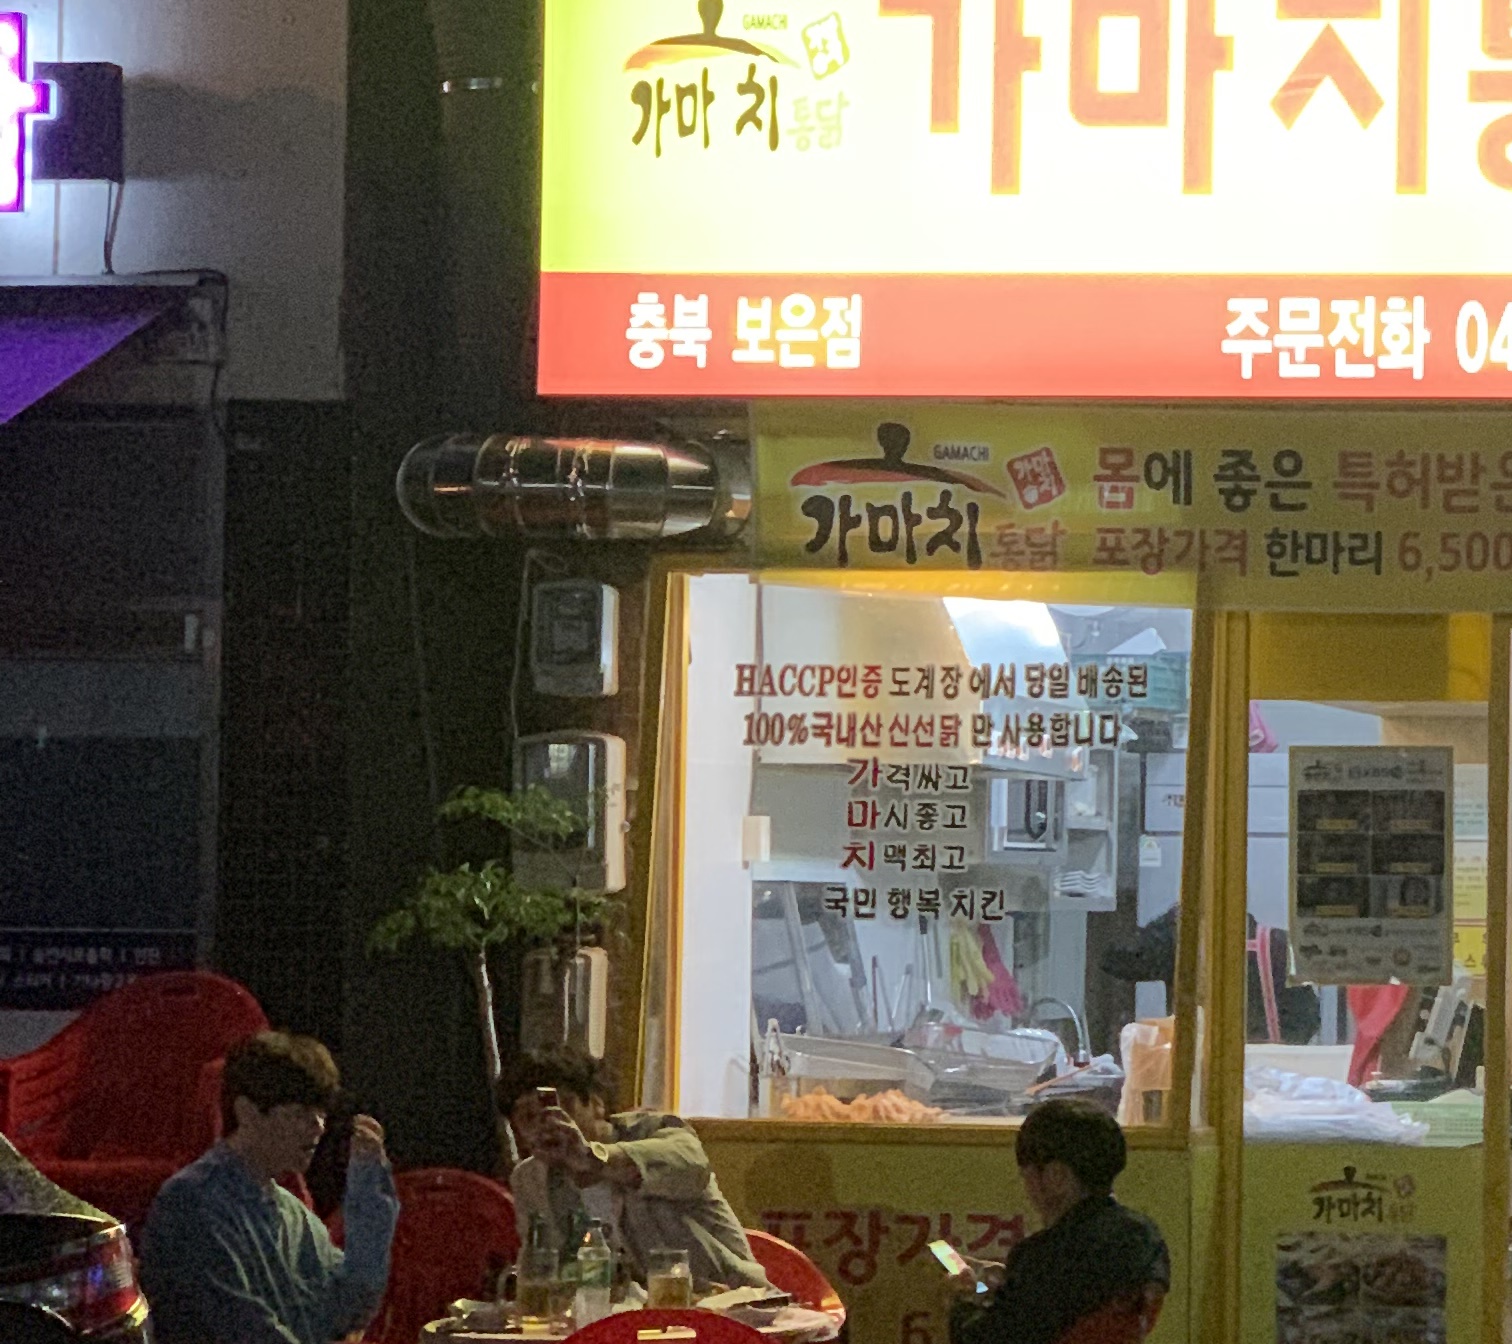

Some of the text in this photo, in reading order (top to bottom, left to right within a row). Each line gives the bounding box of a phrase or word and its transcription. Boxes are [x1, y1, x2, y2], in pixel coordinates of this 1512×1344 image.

[630, 62, 780, 158] 가마치
[625, 291, 863, 370] 충북 보은점
[1220, 294, 1431, 380] 주문전화
[1093, 446, 1193, 510] 몸에
[1212, 448, 1313, 514] 좋은
[800, 488, 1067, 570] 가마치 통닭
[1092, 526, 1248, 578] 포장가격
[1263, 526, 1383, 578] 한마리
[1076, 662, 1148, 699] 배송된
[1000, 711, 1122, 748] 사용합니다
[824, 886, 1004, 921] 국민 행복 치킨
